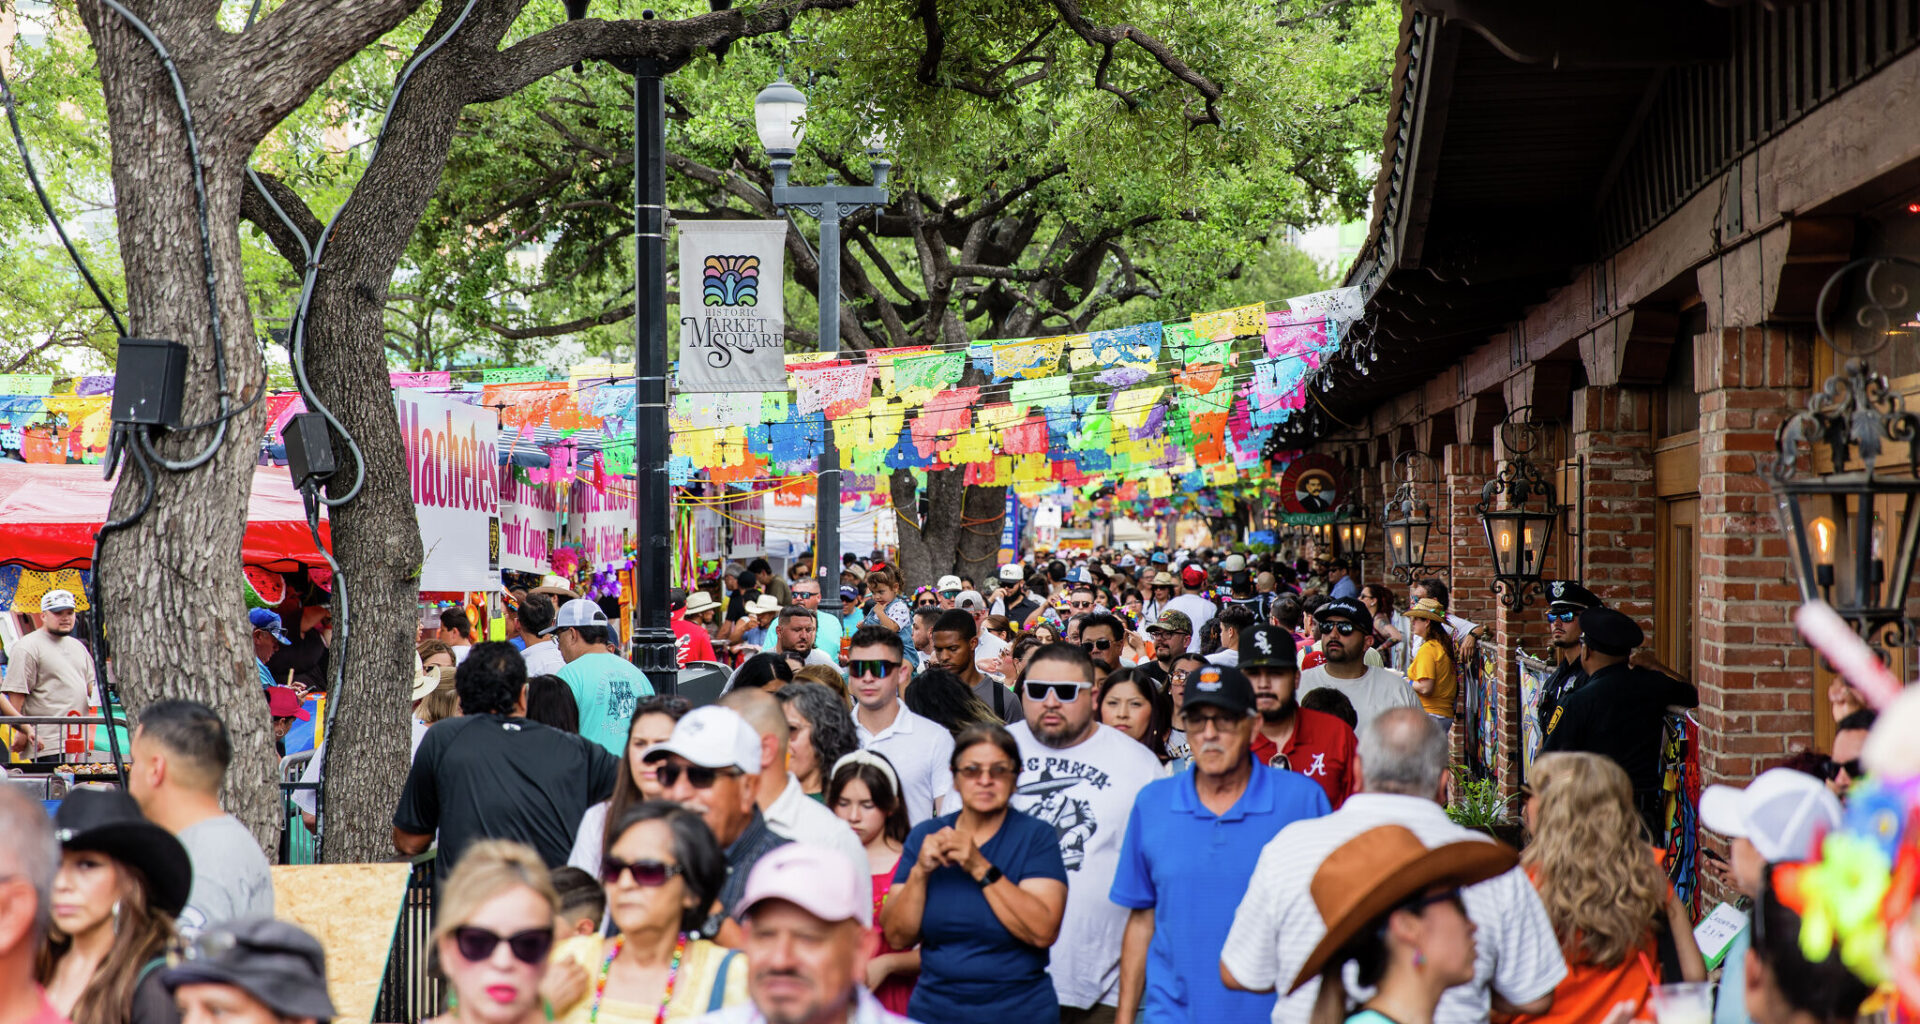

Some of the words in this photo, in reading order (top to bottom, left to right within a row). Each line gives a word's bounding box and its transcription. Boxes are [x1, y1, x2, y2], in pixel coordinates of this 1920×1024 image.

[705, 308, 758, 317] HISTORIC
[681, 317, 767, 348] MARKET
[707, 333, 784, 368] SQUARE
[400, 399, 498, 514] Machetes
[524, 517, 546, 568] Cups
